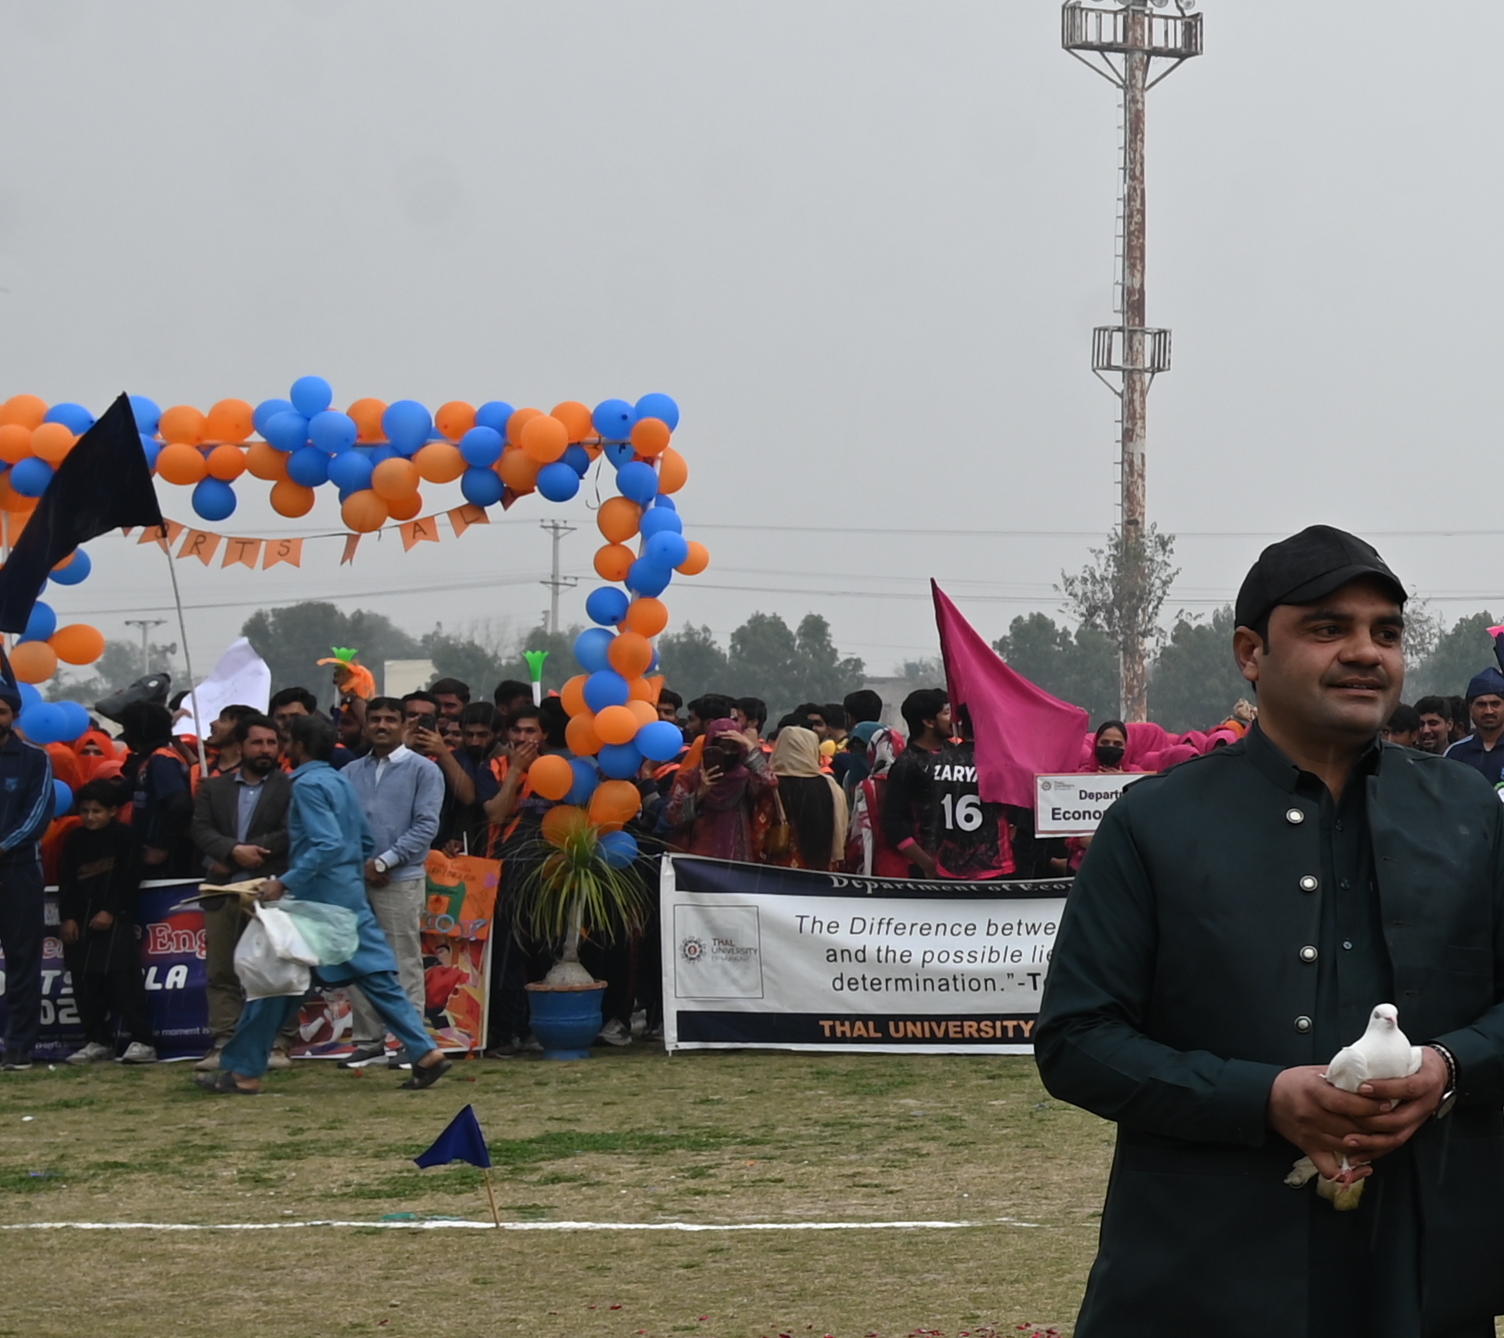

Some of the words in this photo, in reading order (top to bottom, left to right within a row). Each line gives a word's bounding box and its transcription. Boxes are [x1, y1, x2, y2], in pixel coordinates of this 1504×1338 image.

[1079, 789, 1123, 803] Depart
[940, 793, 984, 832] 16
[1051, 807, 1104, 821] Econo
[794, 914, 840, 935] The
[849, 916, 977, 937] Difference
[985, 918, 1056, 937] betwe
[826, 945, 866, 964] and
[876, 945, 912, 964] the
[922, 945, 1023, 968] possible
[819, 1019, 882, 1039] THAL
[888, 1018, 1036, 1039] UNIVERSITY
